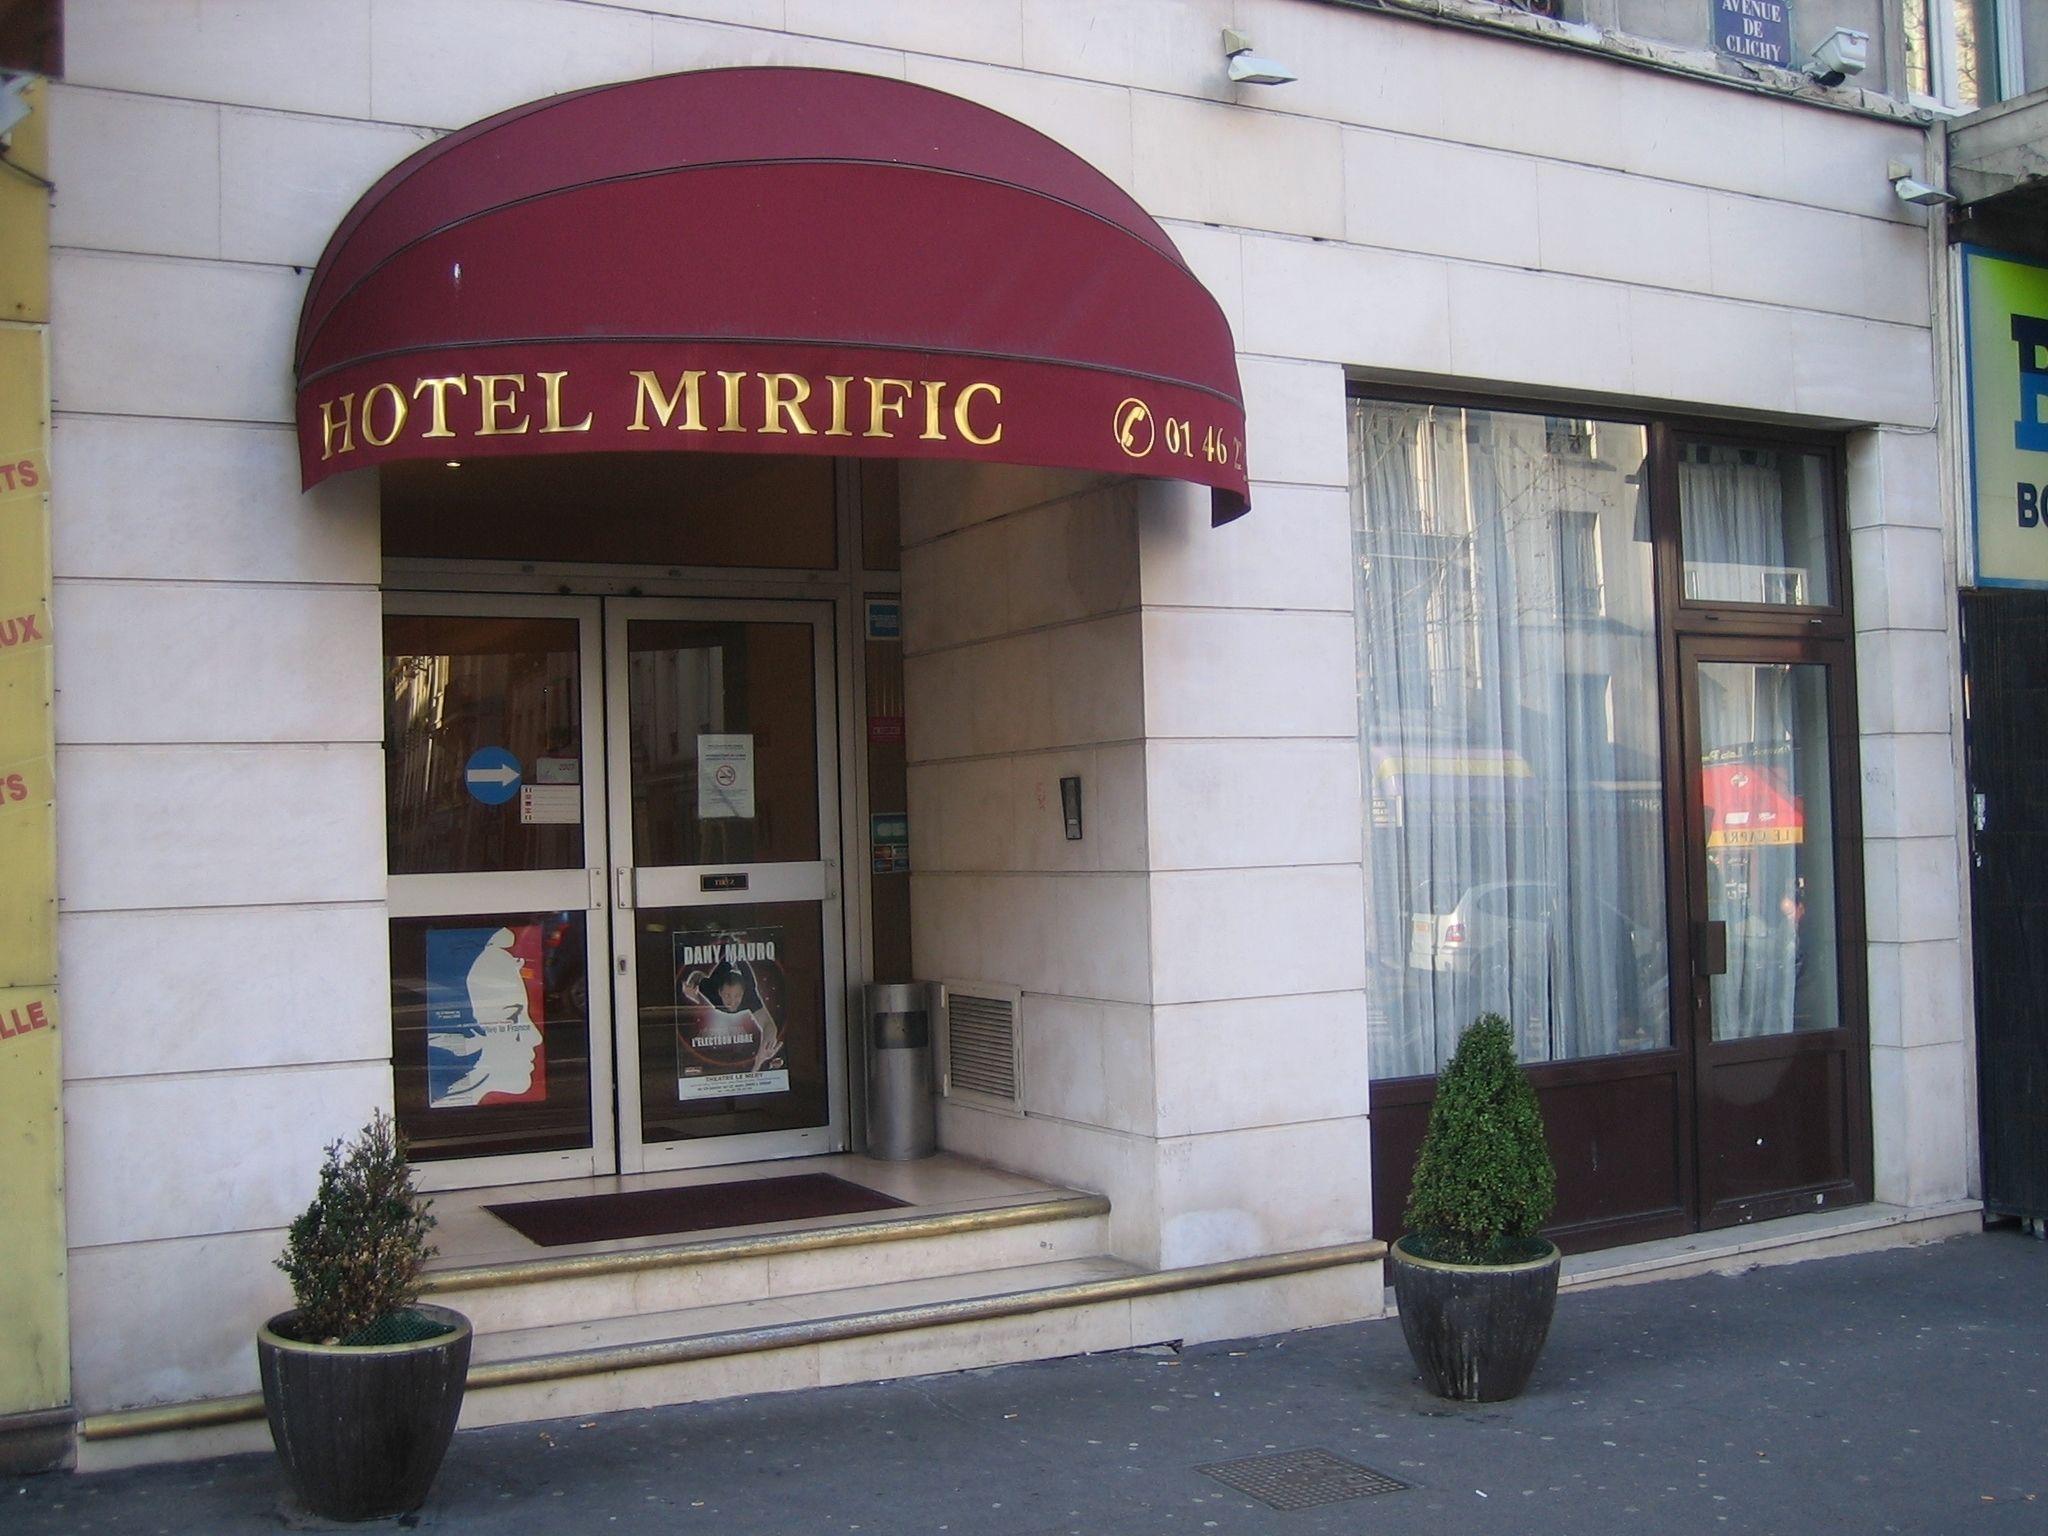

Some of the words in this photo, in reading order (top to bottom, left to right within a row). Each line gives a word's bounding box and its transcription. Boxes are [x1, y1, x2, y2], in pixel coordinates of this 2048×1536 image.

[1722, 0, 1782, 23] AVENUE
[1743, 17, 1763, 39] DE
[1725, 34, 1782, 63] CLICHY
[319, 370, 593, 461] HOTEL
[626, 370, 1002, 445] MIRIFIC
[1165, 417, 1194, 458] 01
[1201, 425, 1229, 465] 46
[0, 460, 39, 492] TS
[0, 614, 43, 648] UX
[684, 943, 722, 966] DANY
